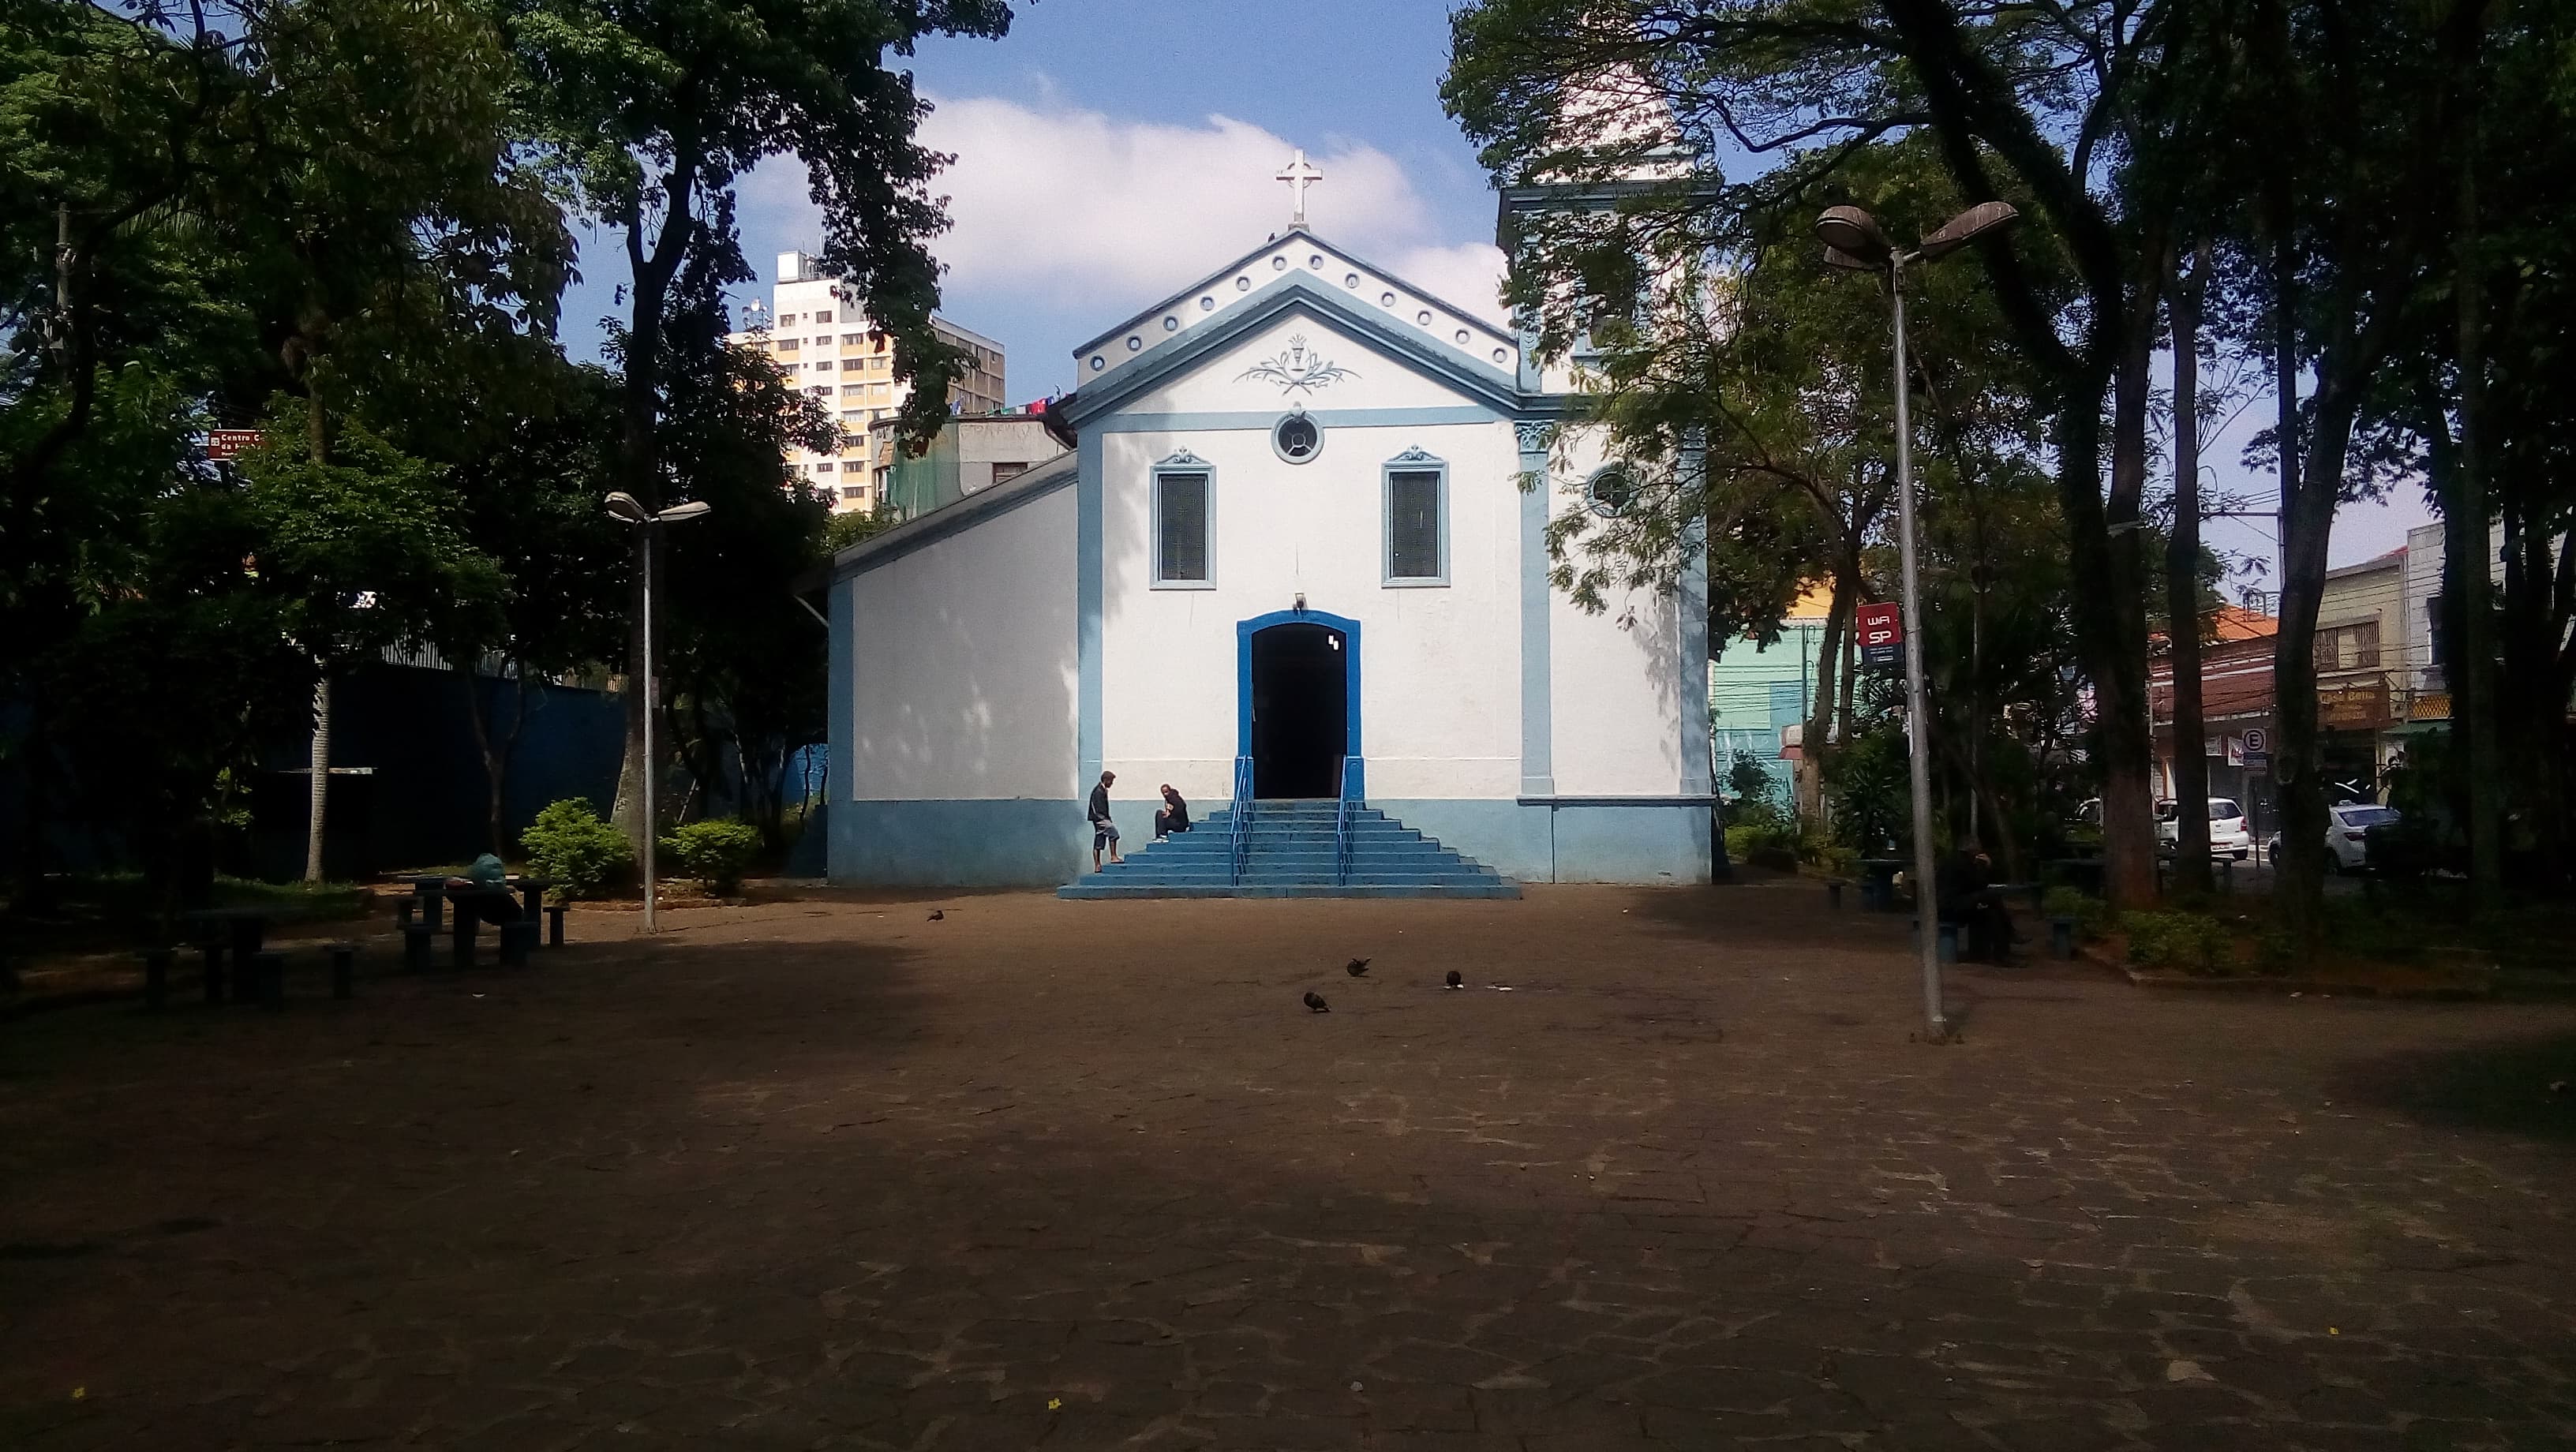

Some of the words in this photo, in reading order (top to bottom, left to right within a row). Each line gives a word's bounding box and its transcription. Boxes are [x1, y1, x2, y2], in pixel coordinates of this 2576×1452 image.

[221, 433, 250, 442] Centro
[1868, 630, 1892, 644] SP
[2249, 735, 2259, 747] E
